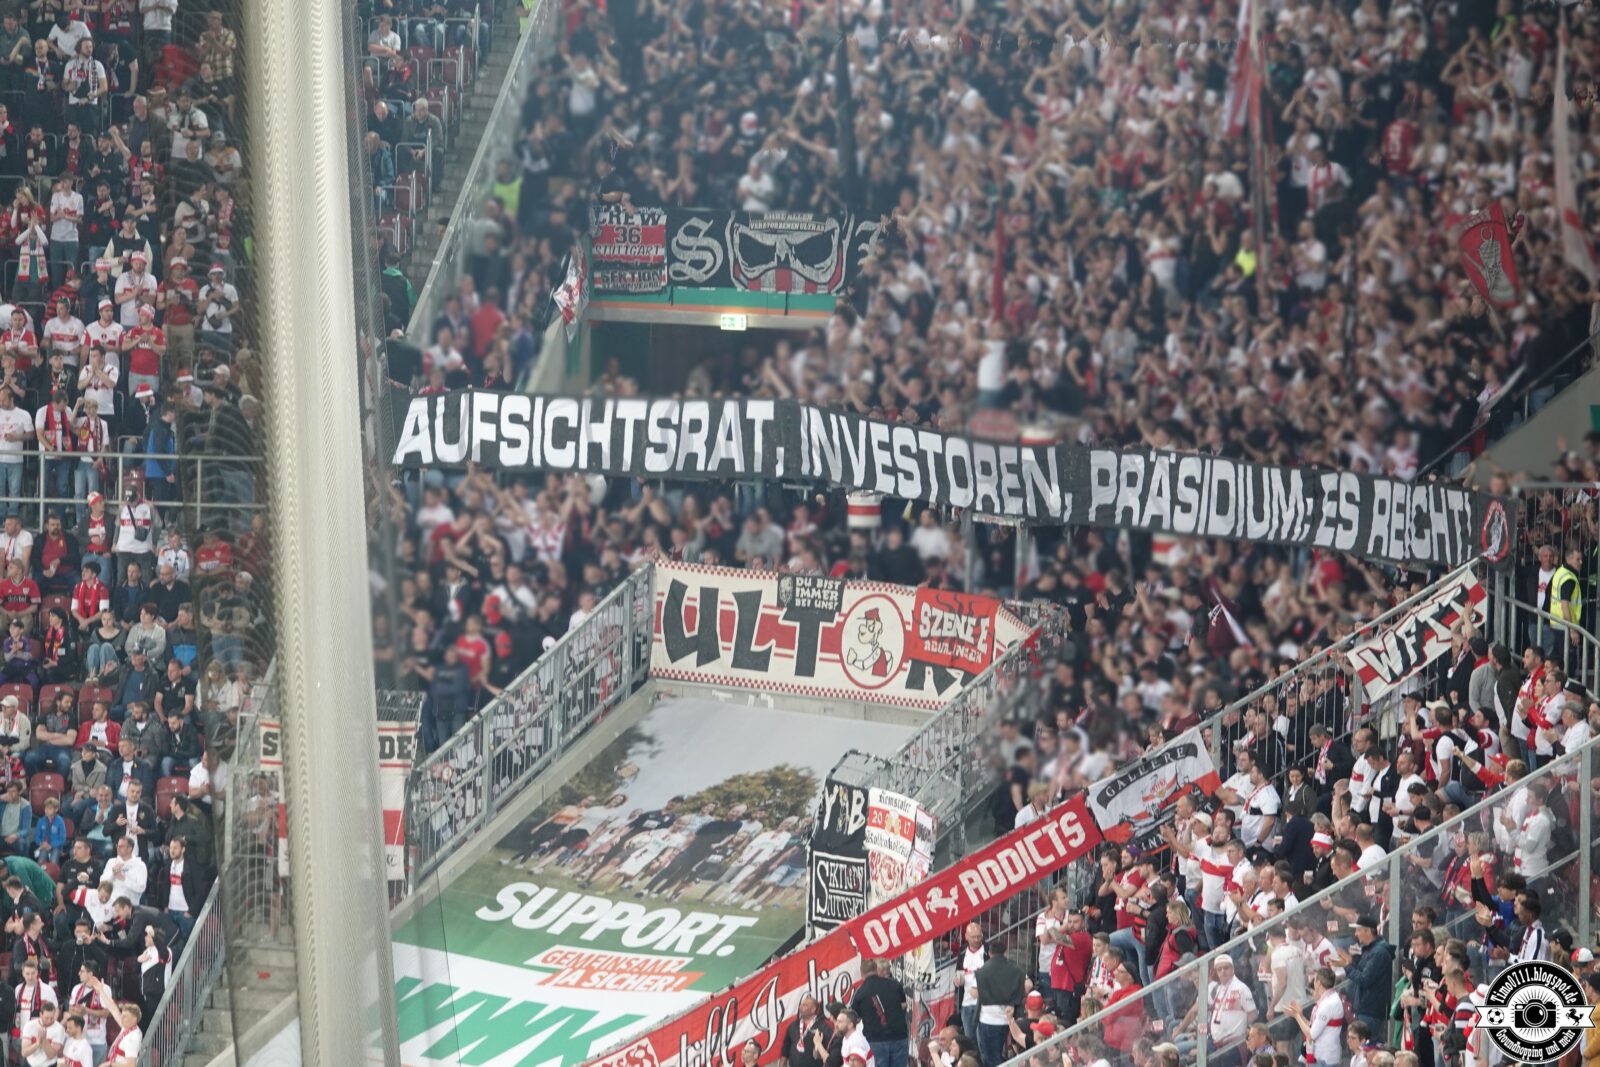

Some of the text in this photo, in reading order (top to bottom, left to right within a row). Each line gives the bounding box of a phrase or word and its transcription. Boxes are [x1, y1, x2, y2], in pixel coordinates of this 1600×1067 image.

[614, 227, 642, 244] 36
[595, 245, 660, 257] STUTTGART
[602, 269, 661, 283] SEKTION
[392, 392, 784, 478] AUFSICHTSRAT,
[800, 405, 1072, 523] INVESTOREN,
[1313, 472, 1360, 550] ES
[1367, 480, 1472, 565] REICHT!
[795, 576, 841, 589] DU BIST
[795, 587, 838, 601] IMMER
[795, 598, 838, 610] BEI UNS!
[919, 602, 990, 654] SZENE E
[879, 790, 911, 813] Remstaler
[871, 810, 883, 824] 20
[903, 820, 911, 835] 17
[863, 897, 933, 956] 0711
[958, 811, 1086, 907] ADDICTS
[474, 881, 759, 957] SUPPORT.
[540, 950, 686, 973] GEMEINSAM?
[545, 968, 688, 992] JA SICHER!
